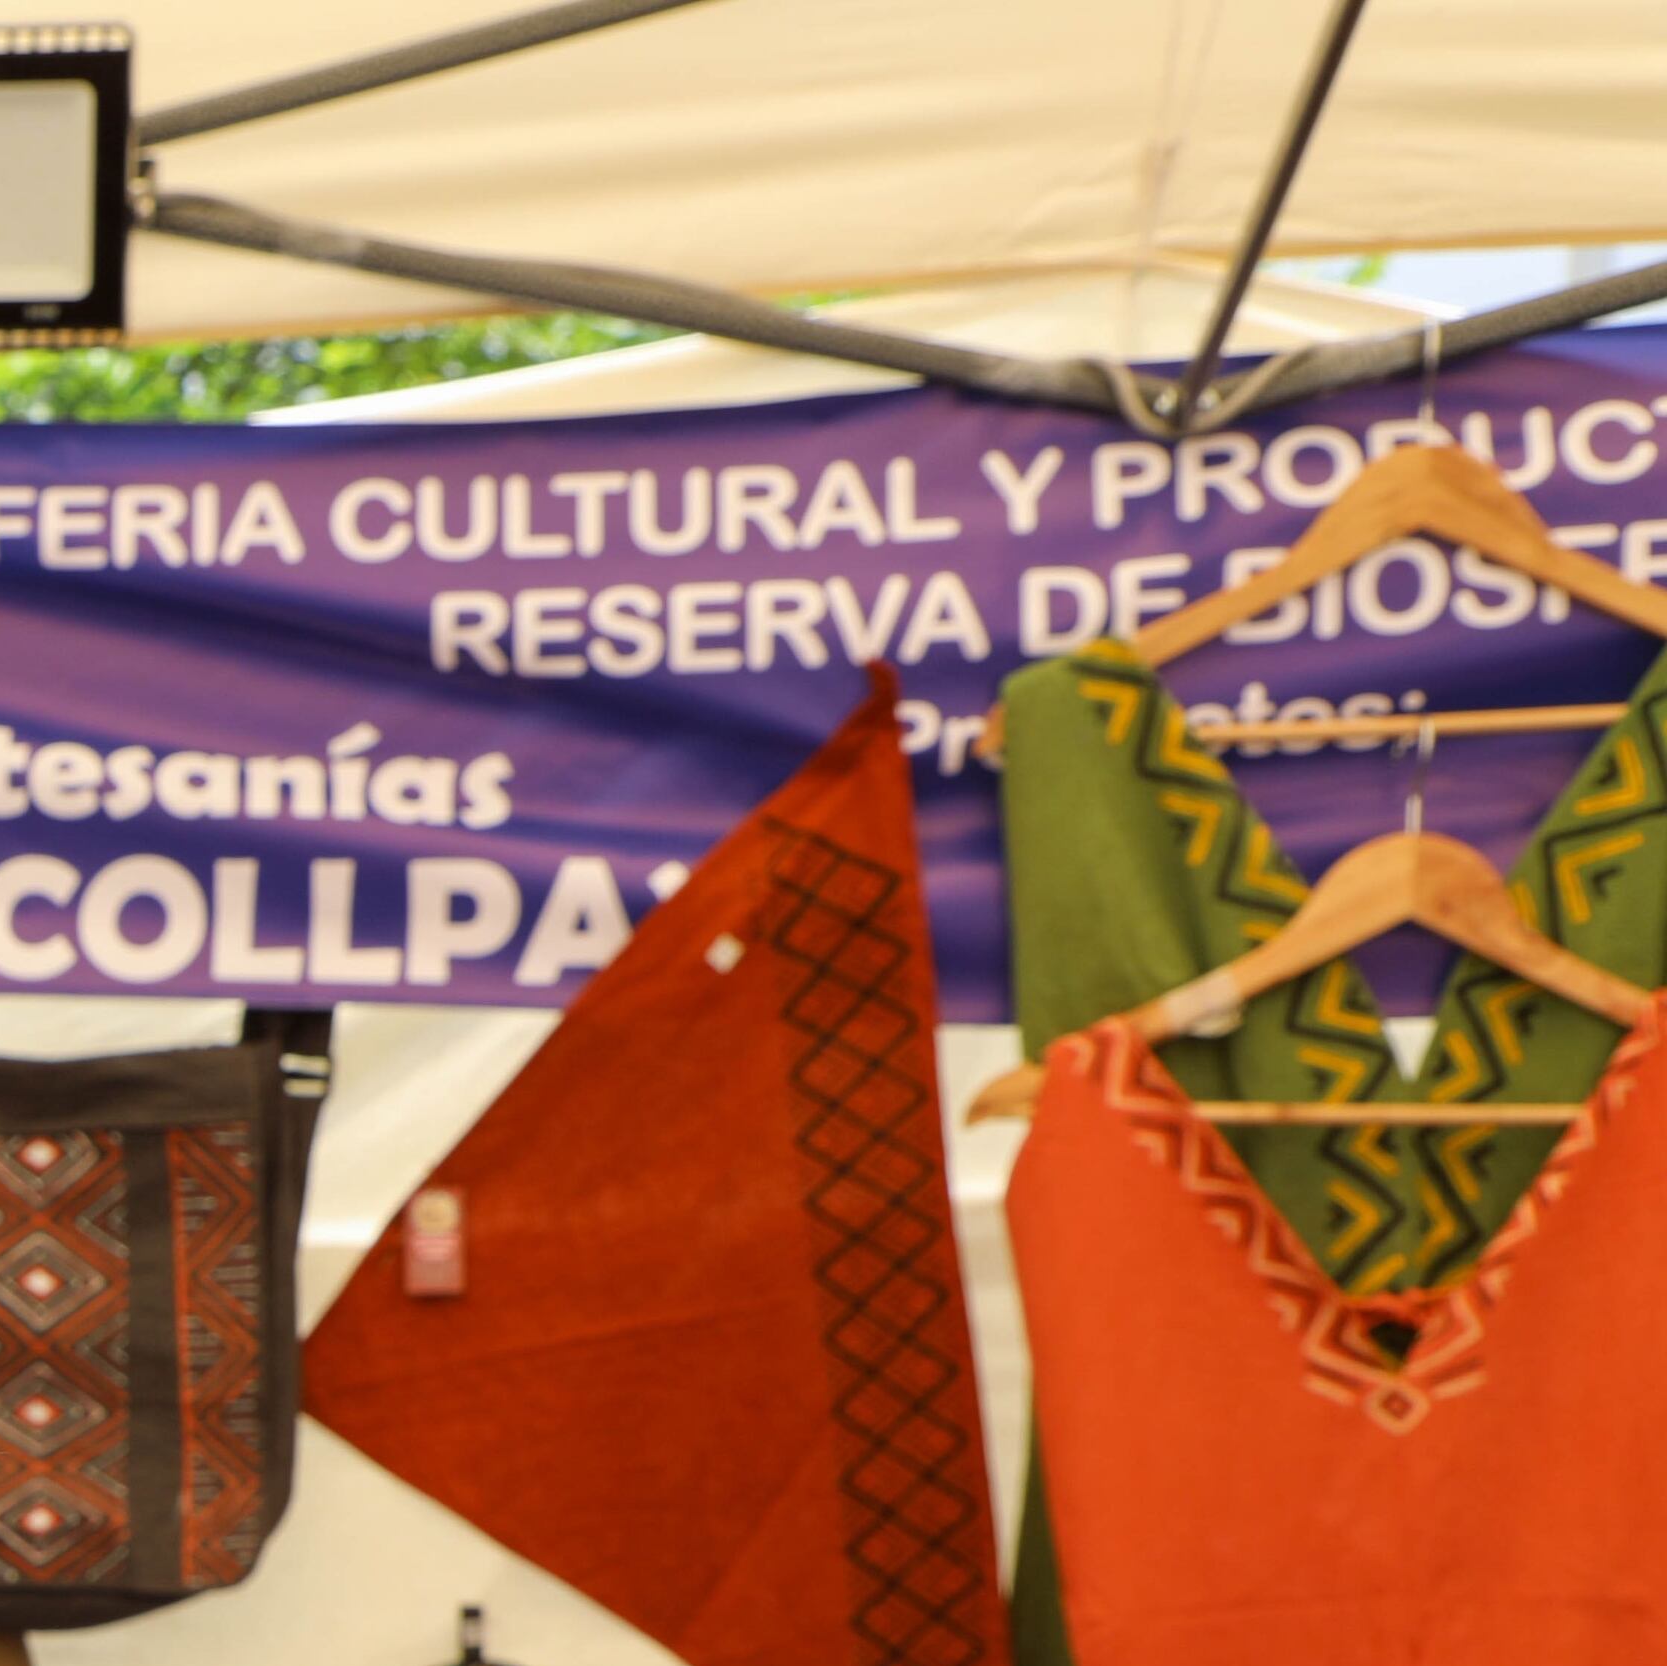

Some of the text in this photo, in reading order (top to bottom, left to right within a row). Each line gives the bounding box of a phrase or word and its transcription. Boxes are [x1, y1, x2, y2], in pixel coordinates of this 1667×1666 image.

[328, 456, 961, 564] CULTURAL
[980, 445, 1064, 536] Y
[1091, 398, 1667, 530] PROUC
[429, 570, 991, 679] RESERVA
